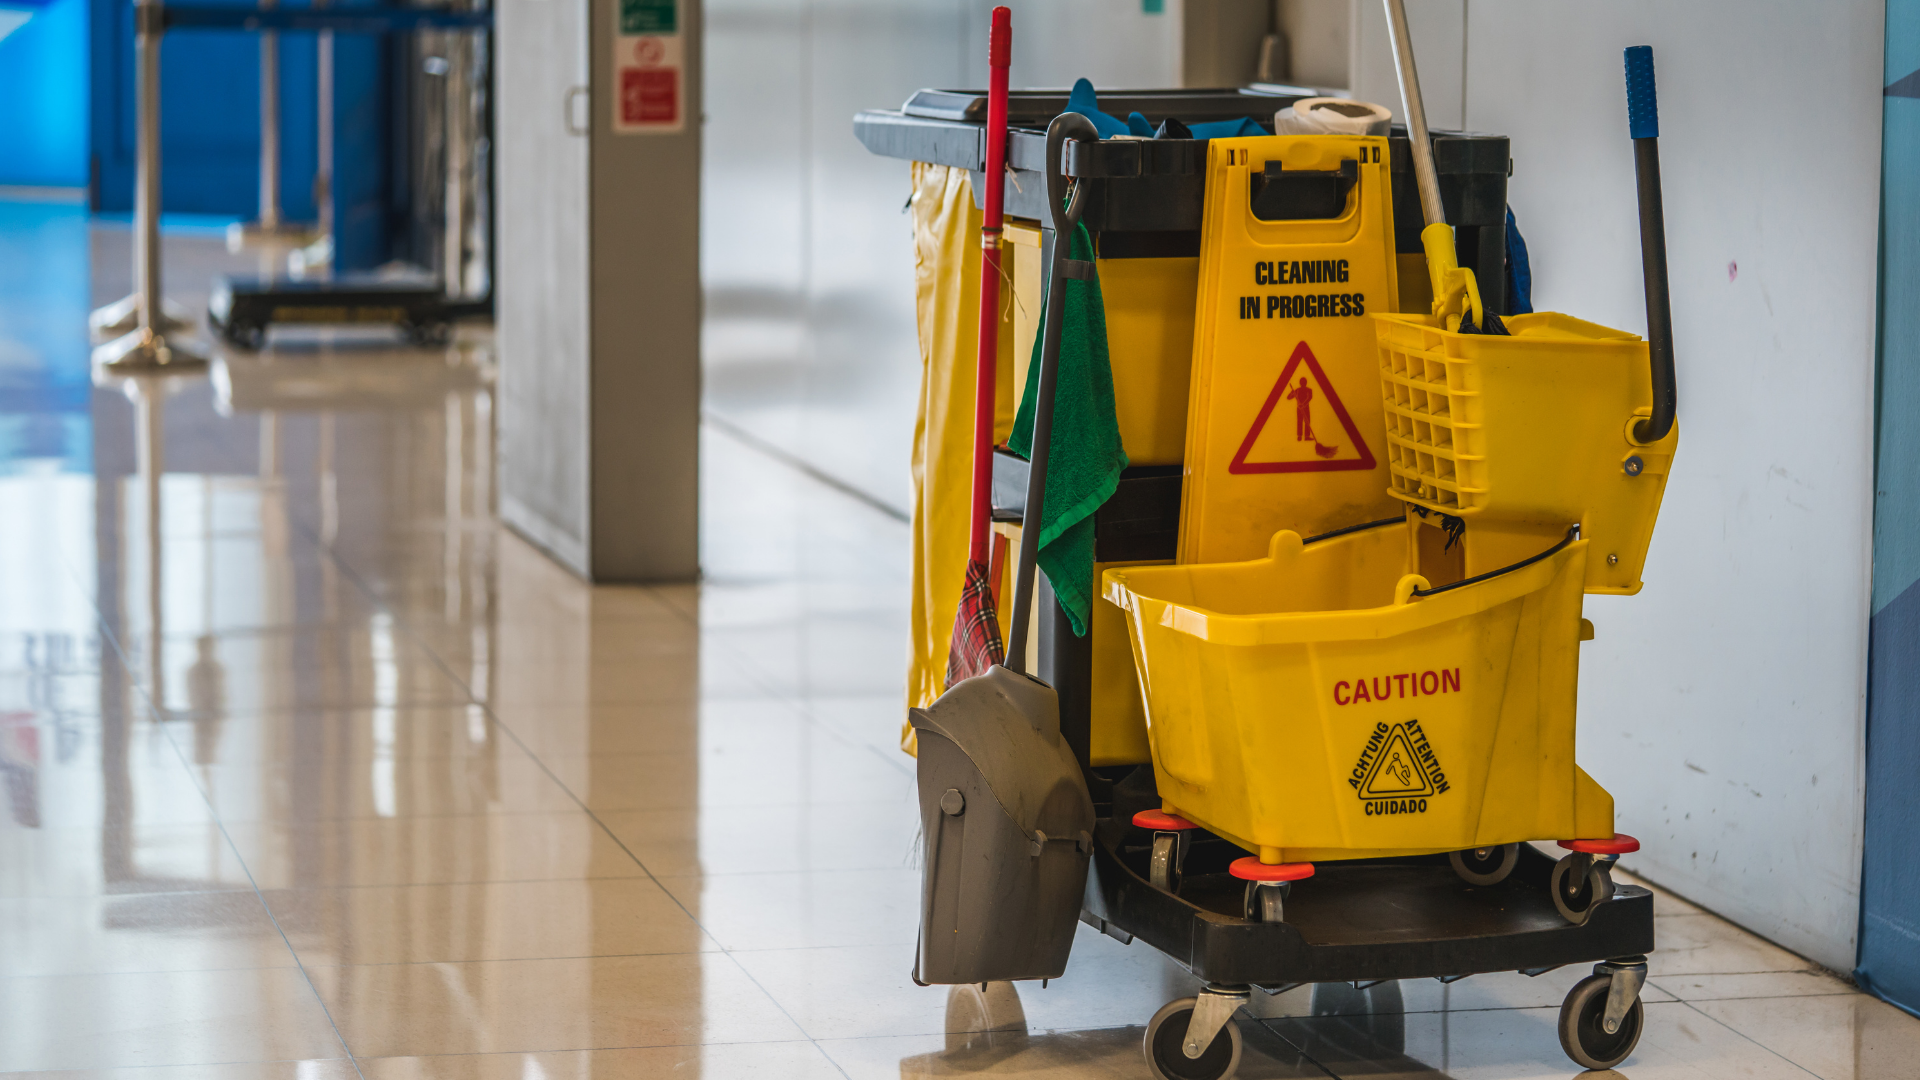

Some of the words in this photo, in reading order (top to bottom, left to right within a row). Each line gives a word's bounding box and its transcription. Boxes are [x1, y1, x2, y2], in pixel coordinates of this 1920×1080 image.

[1255, 259, 1349, 285] CLEANING
[1240, 296, 1260, 319] IN
[1267, 293, 1364, 318] PROGRESS
[1334, 668, 1460, 705] CAUTION
[1348, 722, 1389, 790] ACHTUNG
[1404, 719, 1450, 794] ATTENTION
[1365, 799, 1427, 815] CUIDADO
